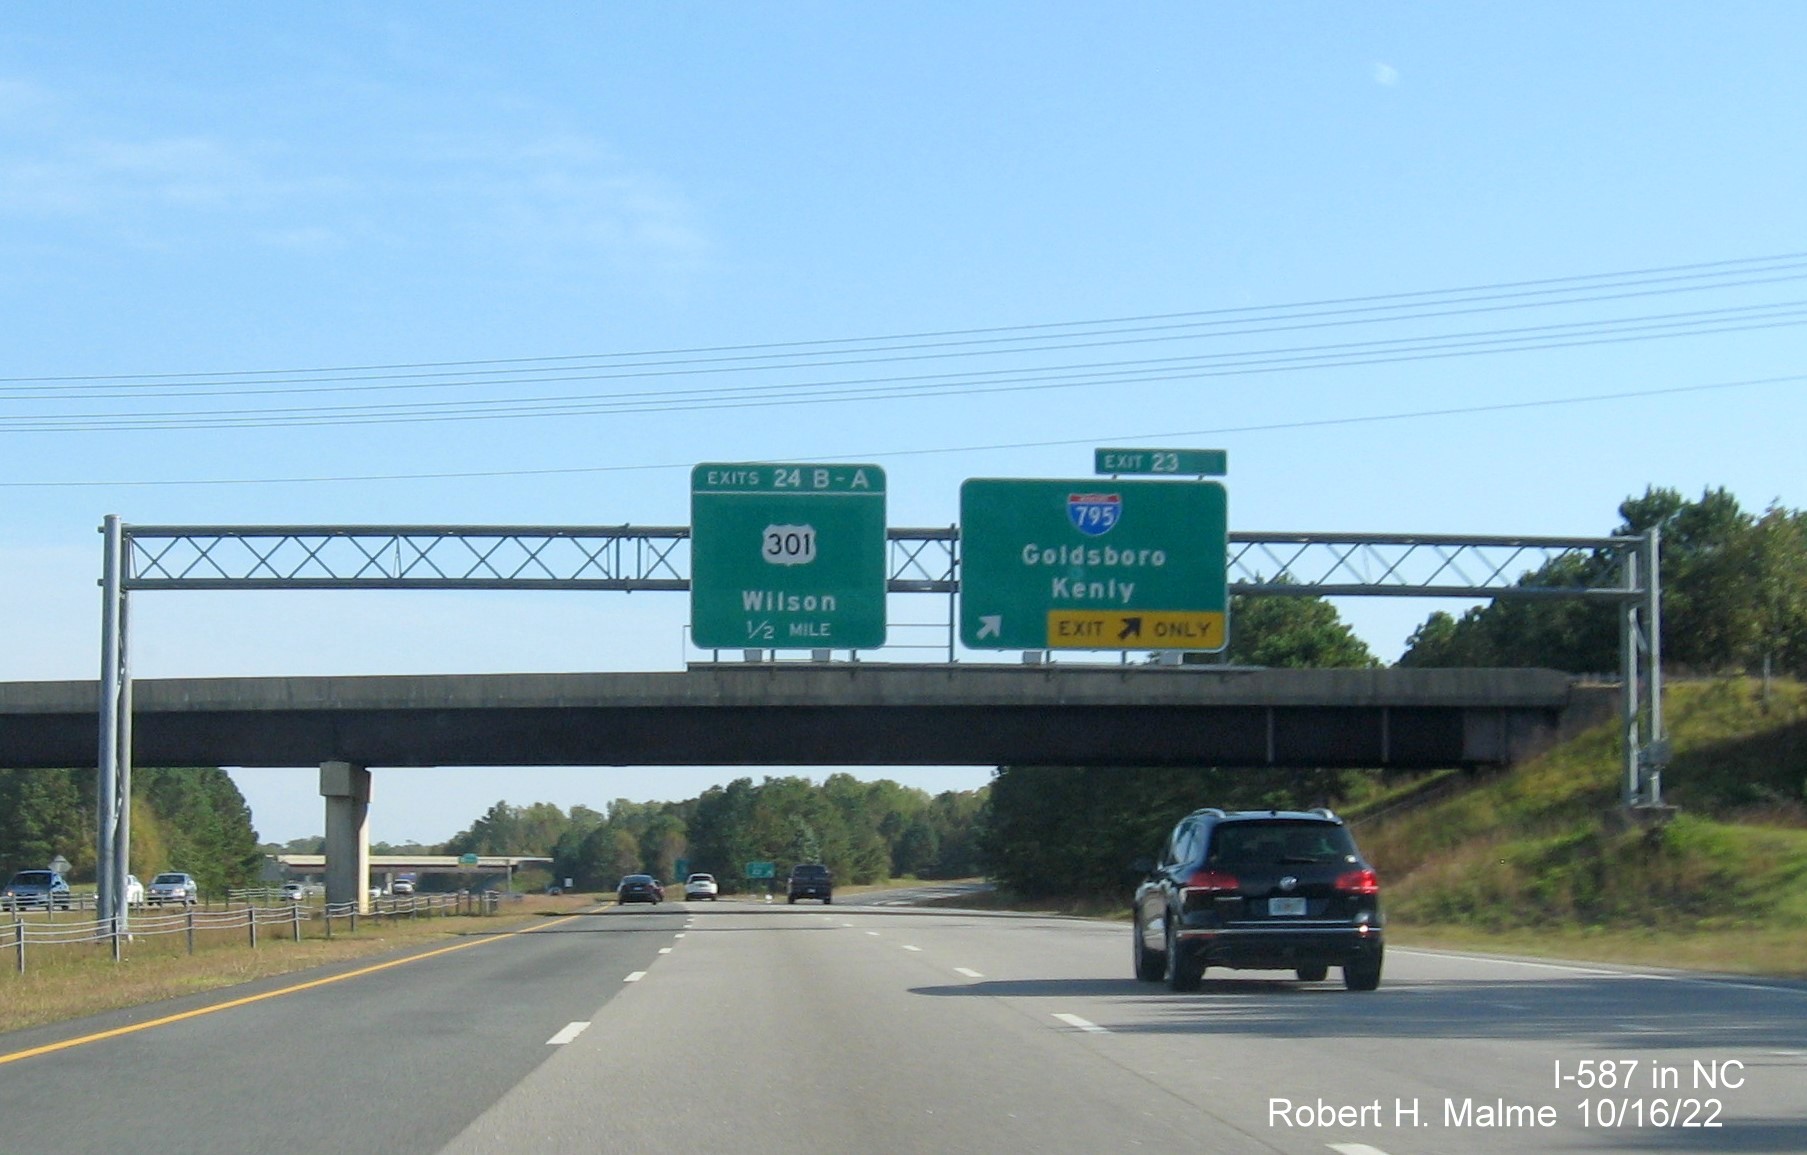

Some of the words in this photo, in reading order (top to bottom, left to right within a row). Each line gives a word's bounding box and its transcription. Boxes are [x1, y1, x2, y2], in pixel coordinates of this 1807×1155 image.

[1104, 455, 1143, 468] EXIT
[1151, 454, 1179, 471] 23
[708, 471, 759, 485] EXITS
[774, 469, 800, 487] 24
[1075, 506, 1114, 526] 795
[768, 533, 810, 555] 301
[1022, 544, 1166, 566] Goldsboro
[1052, 578, 1135, 603] Kenly
[742, 591, 836, 611] Wilson
[789, 624, 831, 636] MILE
[1058, 622, 1104, 636] EXIT
[1154, 623, 1211, 636] ONLY
